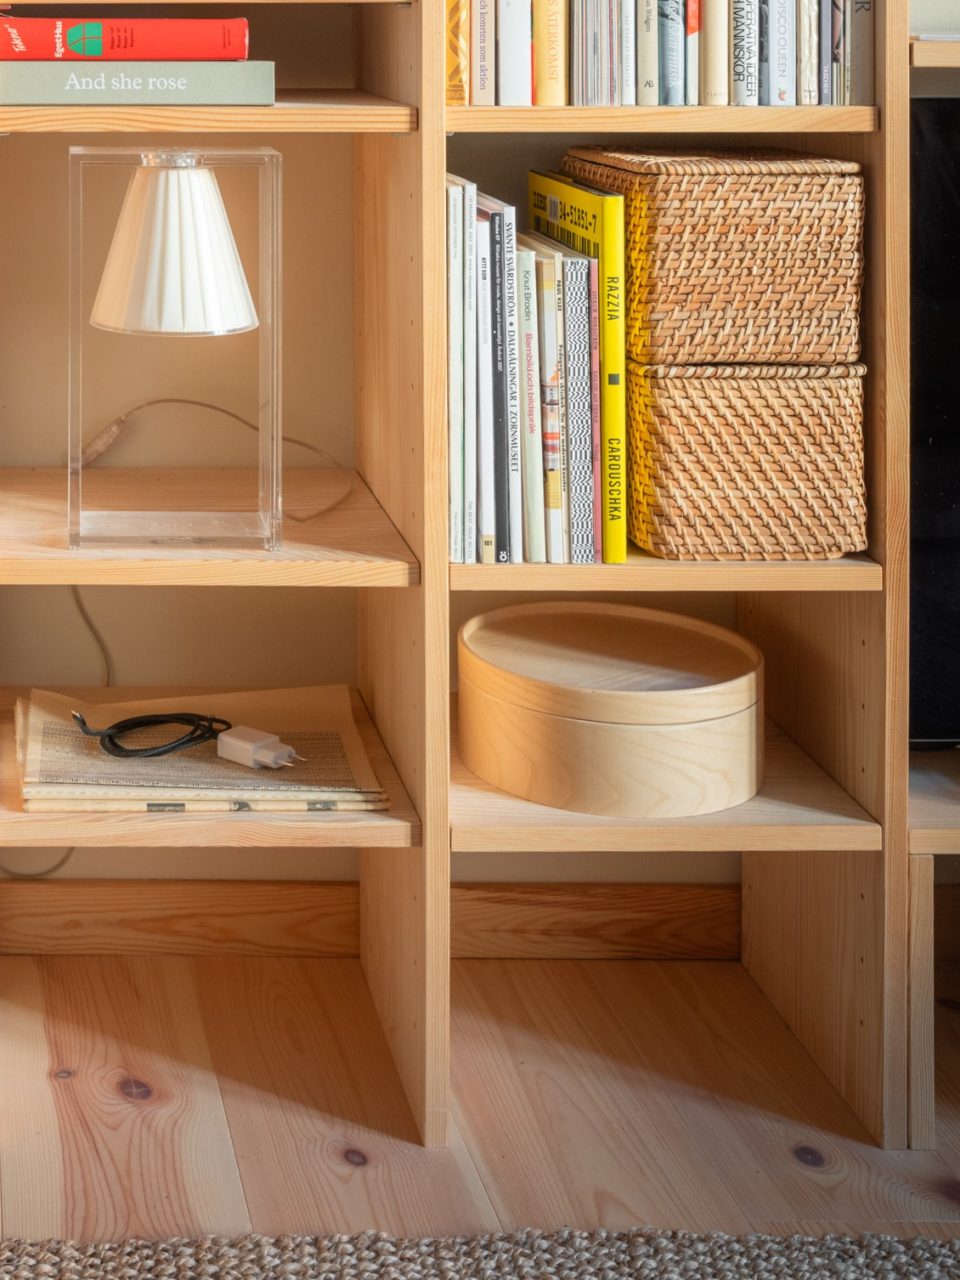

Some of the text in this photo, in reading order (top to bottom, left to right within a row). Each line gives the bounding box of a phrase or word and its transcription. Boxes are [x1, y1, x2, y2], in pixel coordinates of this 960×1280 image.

[479, 12, 488, 43] konsten
[733, 7, 745, 82] MÄNNISKOR
[777, 37, 787, 78] QUEEN
[64, 72, 188, 90] And she rose
[479, 64, 488, 90] aktion
[505, 222, 514, 254] SVANTE
[505, 256, 517, 318] SVÄRDSTRÖM
[523, 270, 532, 290] Knut
[524, 292, 533, 321] Brodin
[606, 276, 621, 522] RAZZIA CAROUSCHKA
[509, 409, 519, 473] ZORNMUSEET
